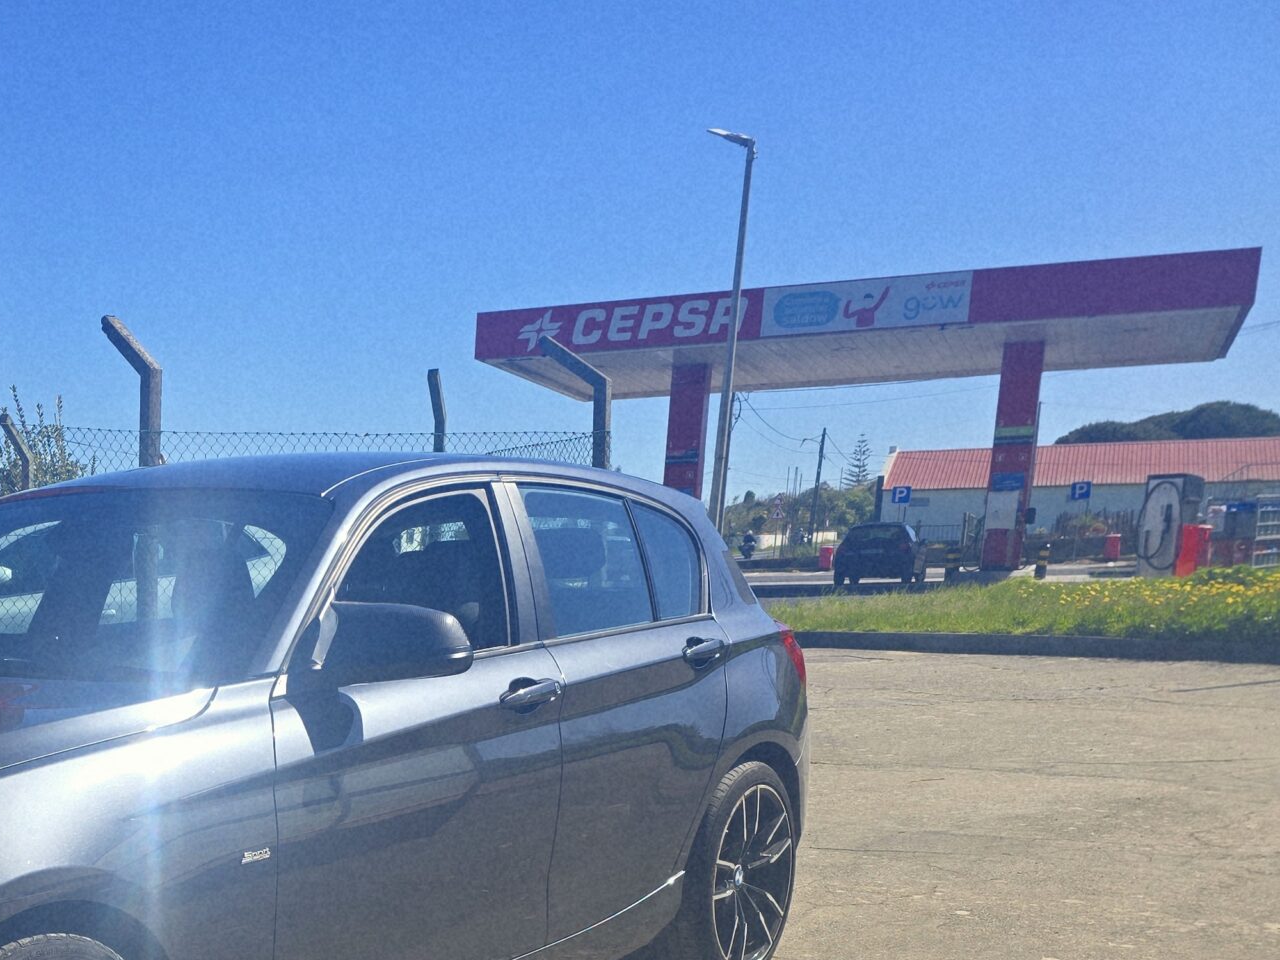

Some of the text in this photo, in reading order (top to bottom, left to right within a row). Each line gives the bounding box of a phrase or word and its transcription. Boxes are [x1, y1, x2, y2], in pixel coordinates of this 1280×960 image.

[572, 297, 749, 345] CEPSA
[895, 487, 908, 502] P
[1076, 483, 1088, 498] P
